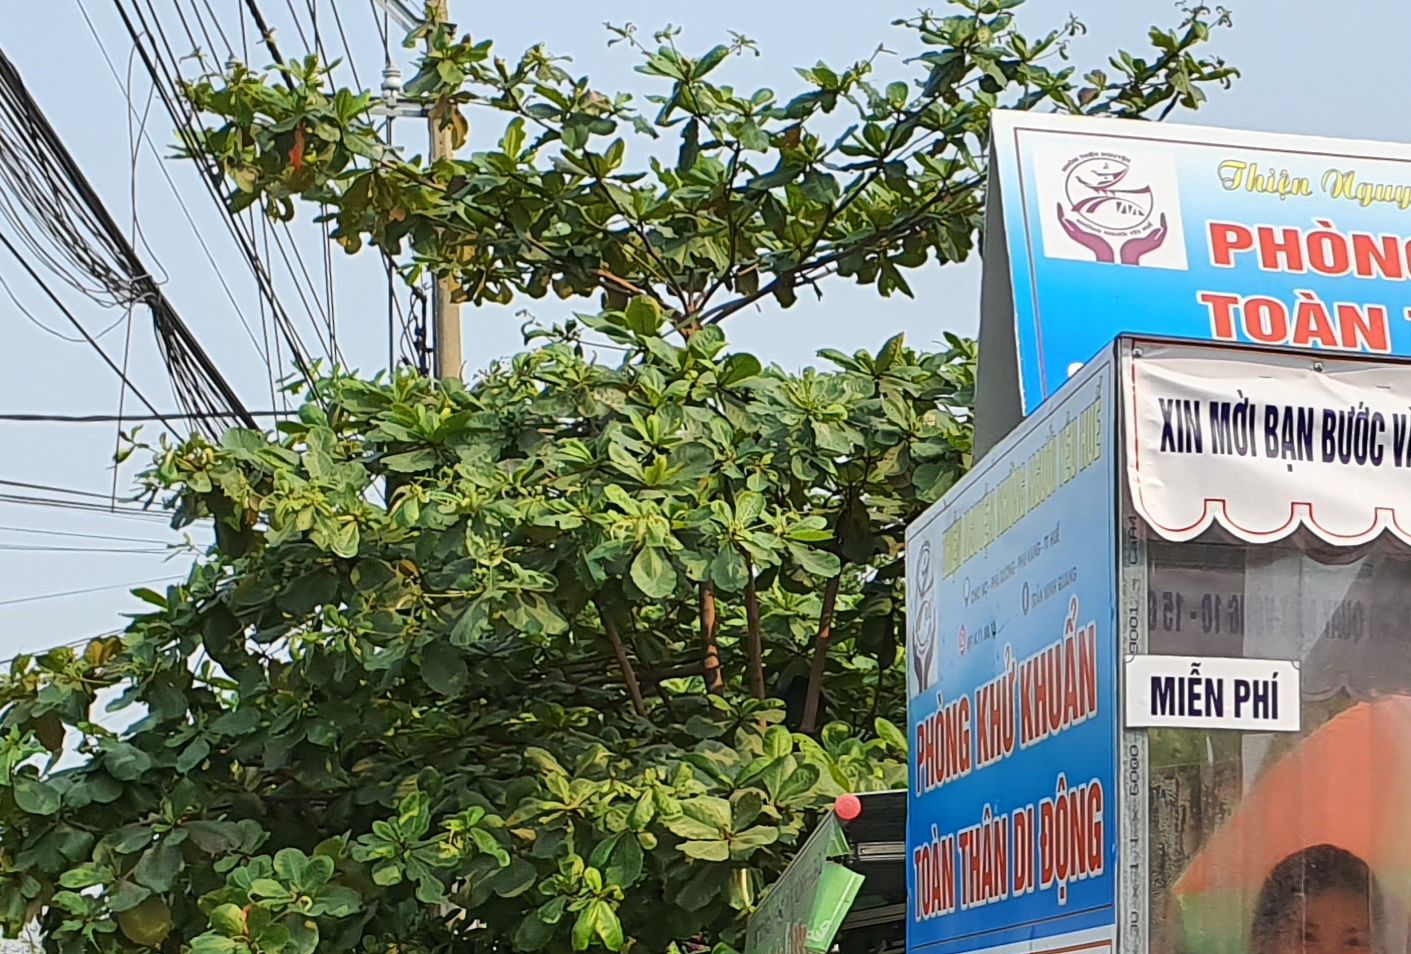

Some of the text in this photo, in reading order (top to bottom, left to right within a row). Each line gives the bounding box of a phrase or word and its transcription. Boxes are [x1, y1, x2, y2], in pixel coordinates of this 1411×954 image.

[1217, 159, 1313, 201] Thiện
[1201, 292, 1388, 352] TOÀN
[1158, 398, 1203, 454] XIN
[1209, 389, 1257, 458] MỜI
[1264, 405, 1314, 472] BẠN
[1322, 401, 1386, 467] BƯỚC
[917, 597, 1095, 793] PHÒNG KHỬ KHUẨN
[1151, 662, 1278, 719] MIỄN PHÍ
[1129, 744, 1139, 797] 6000
[914, 776, 1102, 917] TOÀN THÂN DI ĐỘNG
